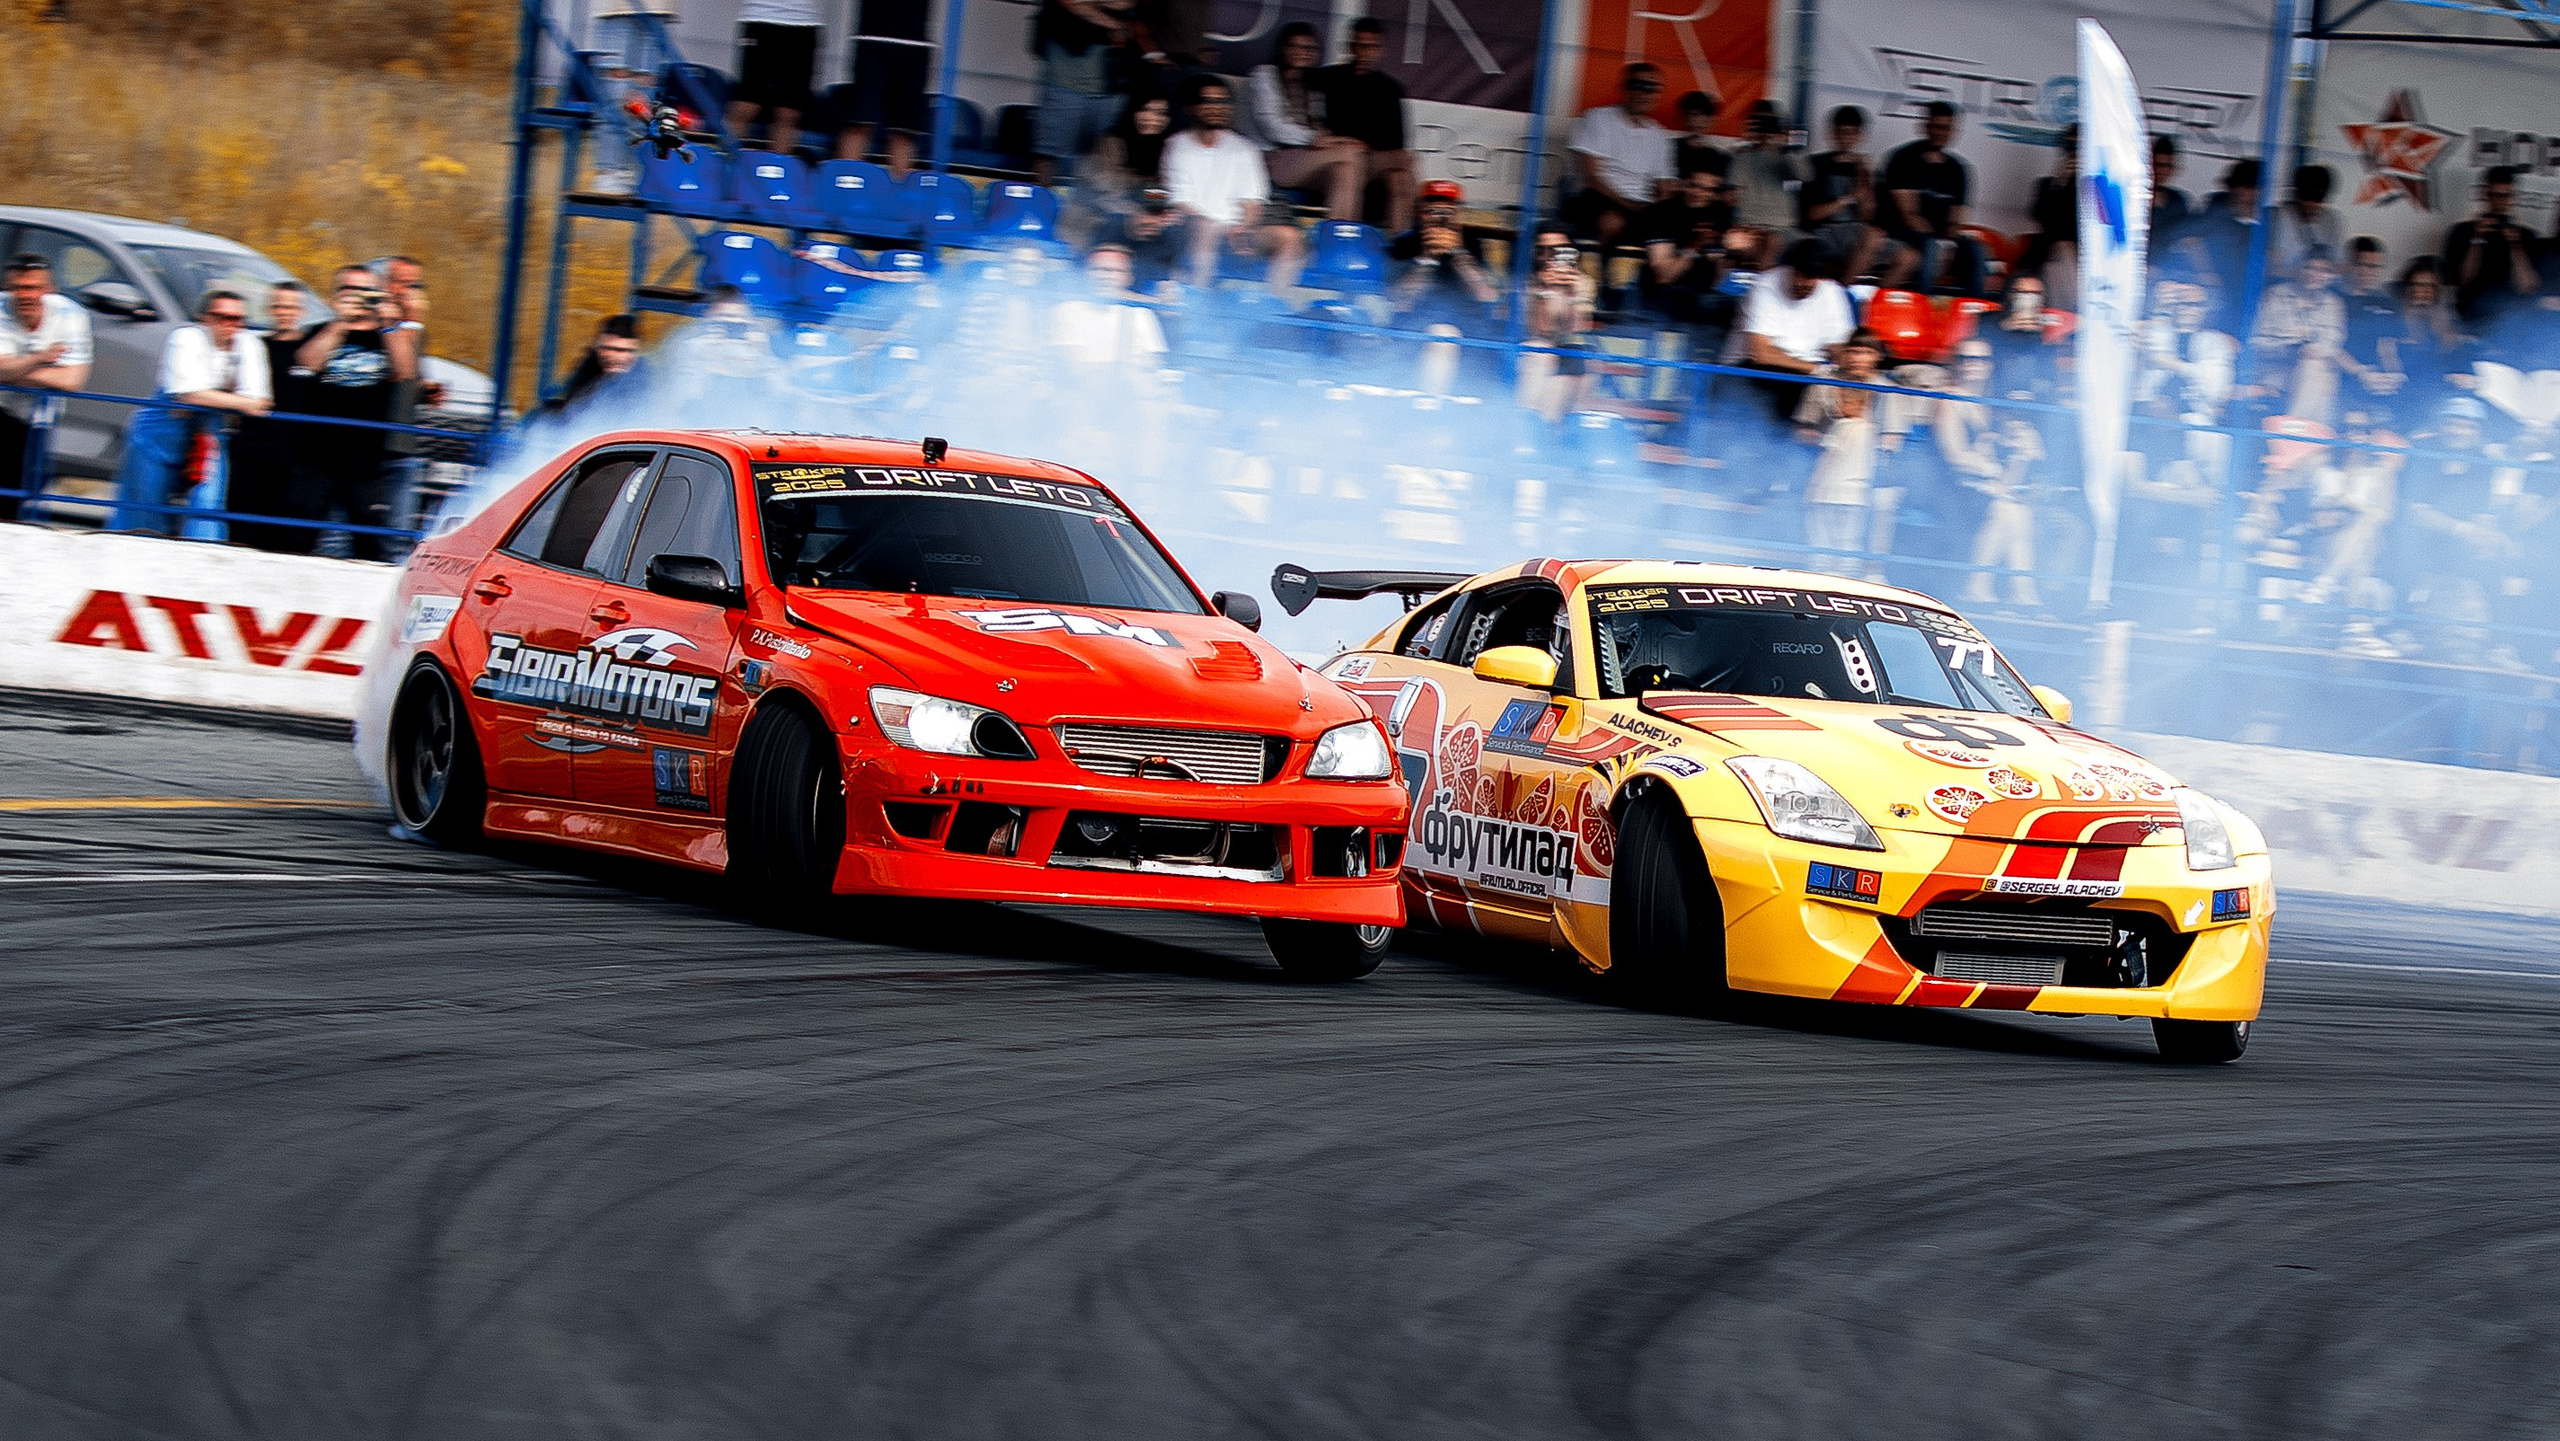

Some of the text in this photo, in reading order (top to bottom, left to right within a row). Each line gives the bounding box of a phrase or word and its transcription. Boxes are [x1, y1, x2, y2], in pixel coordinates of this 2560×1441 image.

[771, 479, 847, 492] 2025
[855, 469, 1092, 507] DRIFT LETO
[1597, 598, 1669, 613] 2025
[1677, 587, 1909, 623] DRIFT LETO
[957, 608, 1174, 648] SM
[1772, 642, 1824, 655] RECARO
[1935, 635, 1996, 677] 77
[1499, 705, 1557, 739] SKR
[1607, 712, 1673, 742] ALACHEV
[656, 753, 705, 791] SKR
[1814, 866, 1874, 893] SKR
[2215, 891, 2249, 912] SKR
